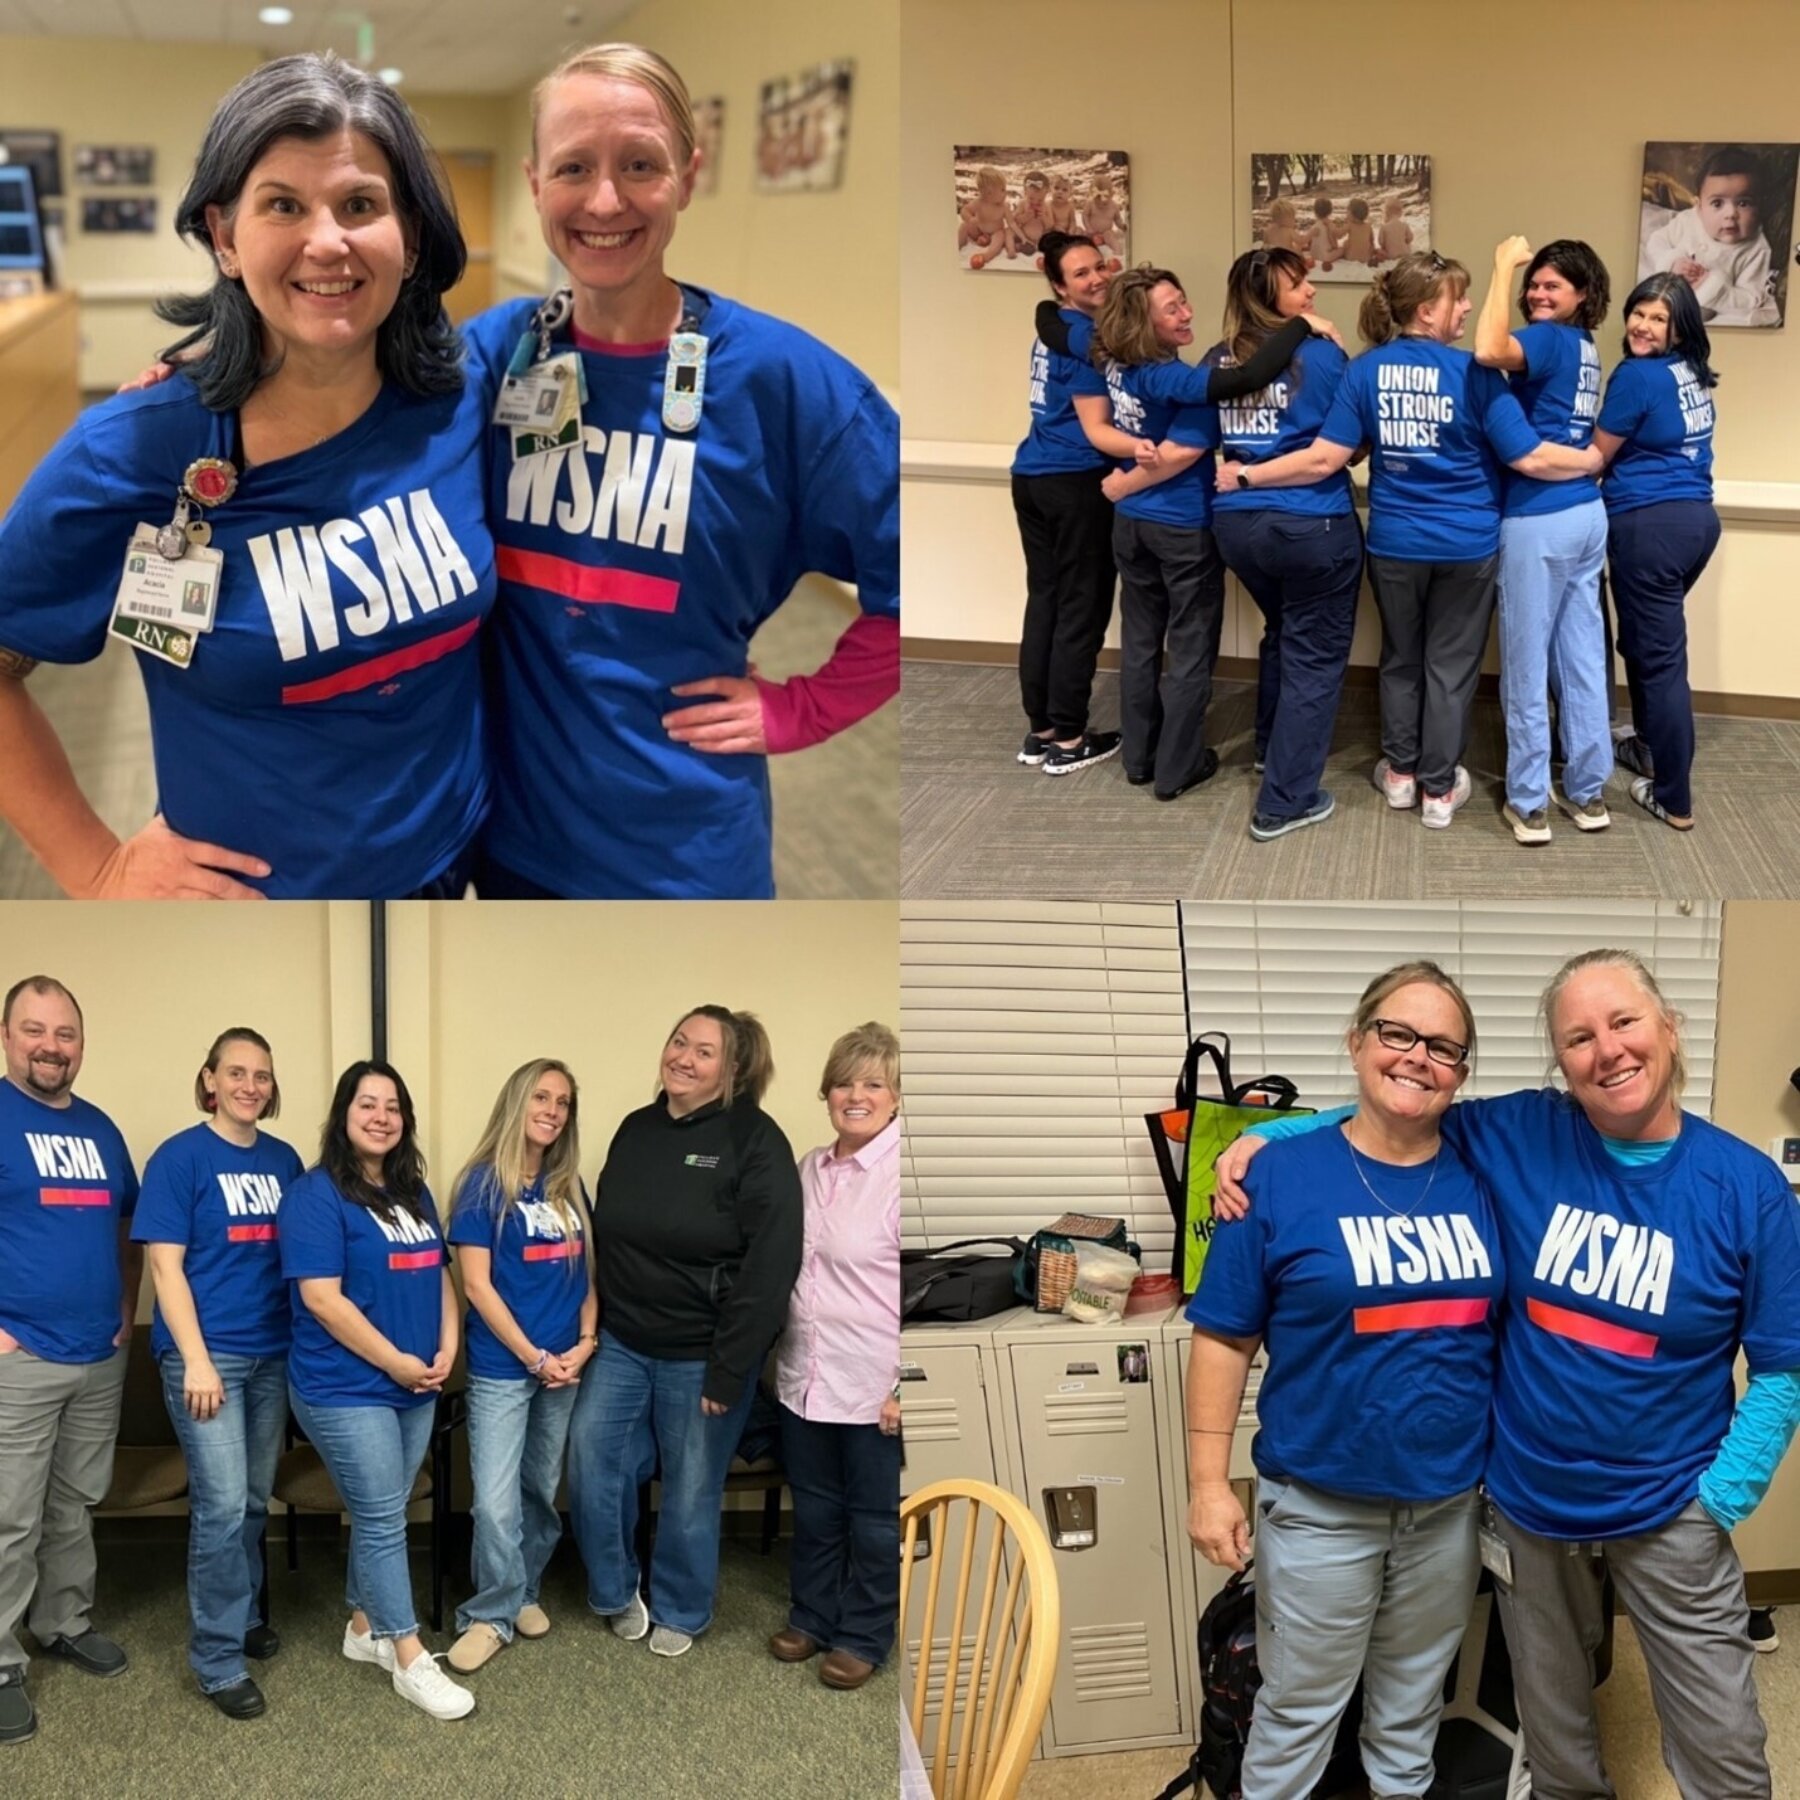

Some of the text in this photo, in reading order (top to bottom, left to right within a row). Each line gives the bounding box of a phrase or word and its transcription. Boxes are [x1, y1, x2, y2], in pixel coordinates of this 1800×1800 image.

[1378, 364, 1440, 393] UNION
[1219, 408, 1280, 434] NURSE
[1378, 391, 1454, 423] STRONG
[1379, 419, 1441, 448] NURSE
[505, 425, 697, 555] WSNA
[246, 488, 479, 663] WSNA
[133, 620, 169, 650] RN
[24, 1132, 108, 1180] WSNA
[1338, 1213, 1492, 1287] WSNA
[1533, 1202, 1675, 1316] WSNA
[1069, 1287, 1111, 1310] OSTABLE
